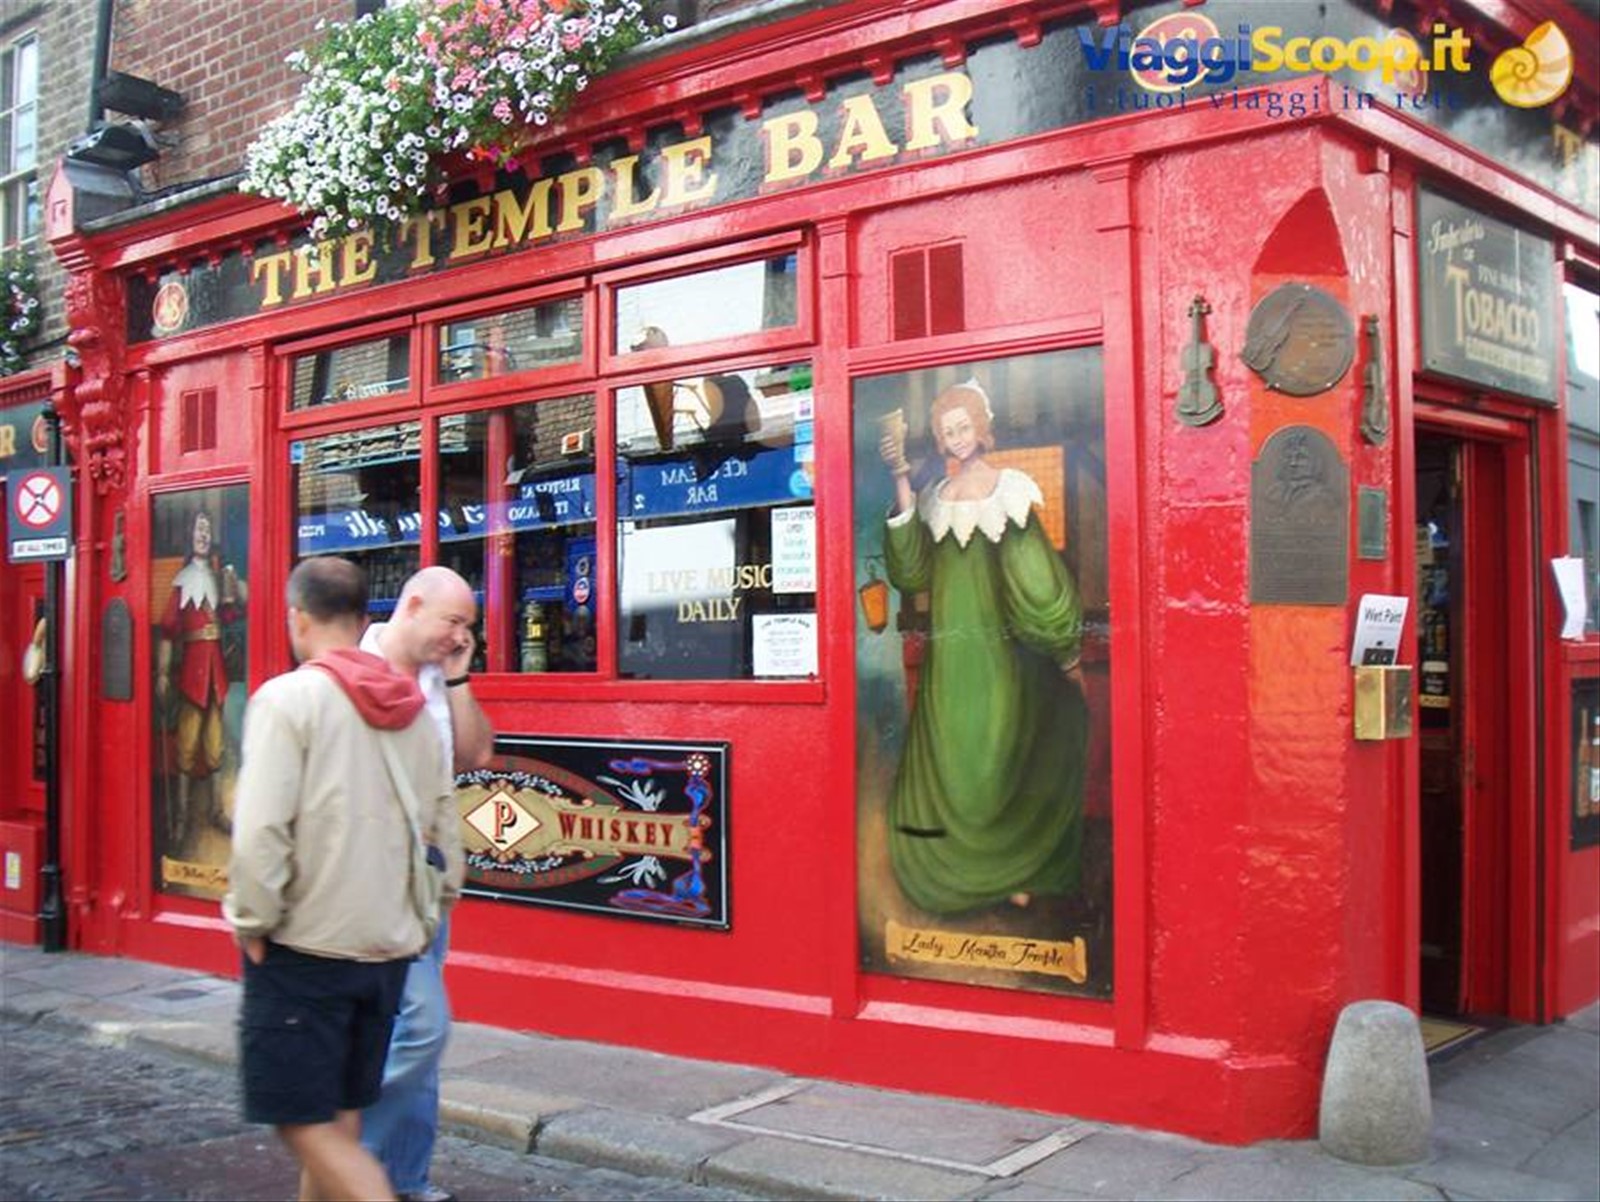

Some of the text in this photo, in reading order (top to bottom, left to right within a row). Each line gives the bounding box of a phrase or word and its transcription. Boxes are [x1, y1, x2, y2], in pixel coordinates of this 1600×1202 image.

[253, 71, 981, 307] THE TEMPLE BAR
[708, 564, 774, 591] MUSIC
[677, 597, 742, 623] DAILY
[557, 812, 674, 846] WHISKEY
[901, 932, 944, 958] Lady
